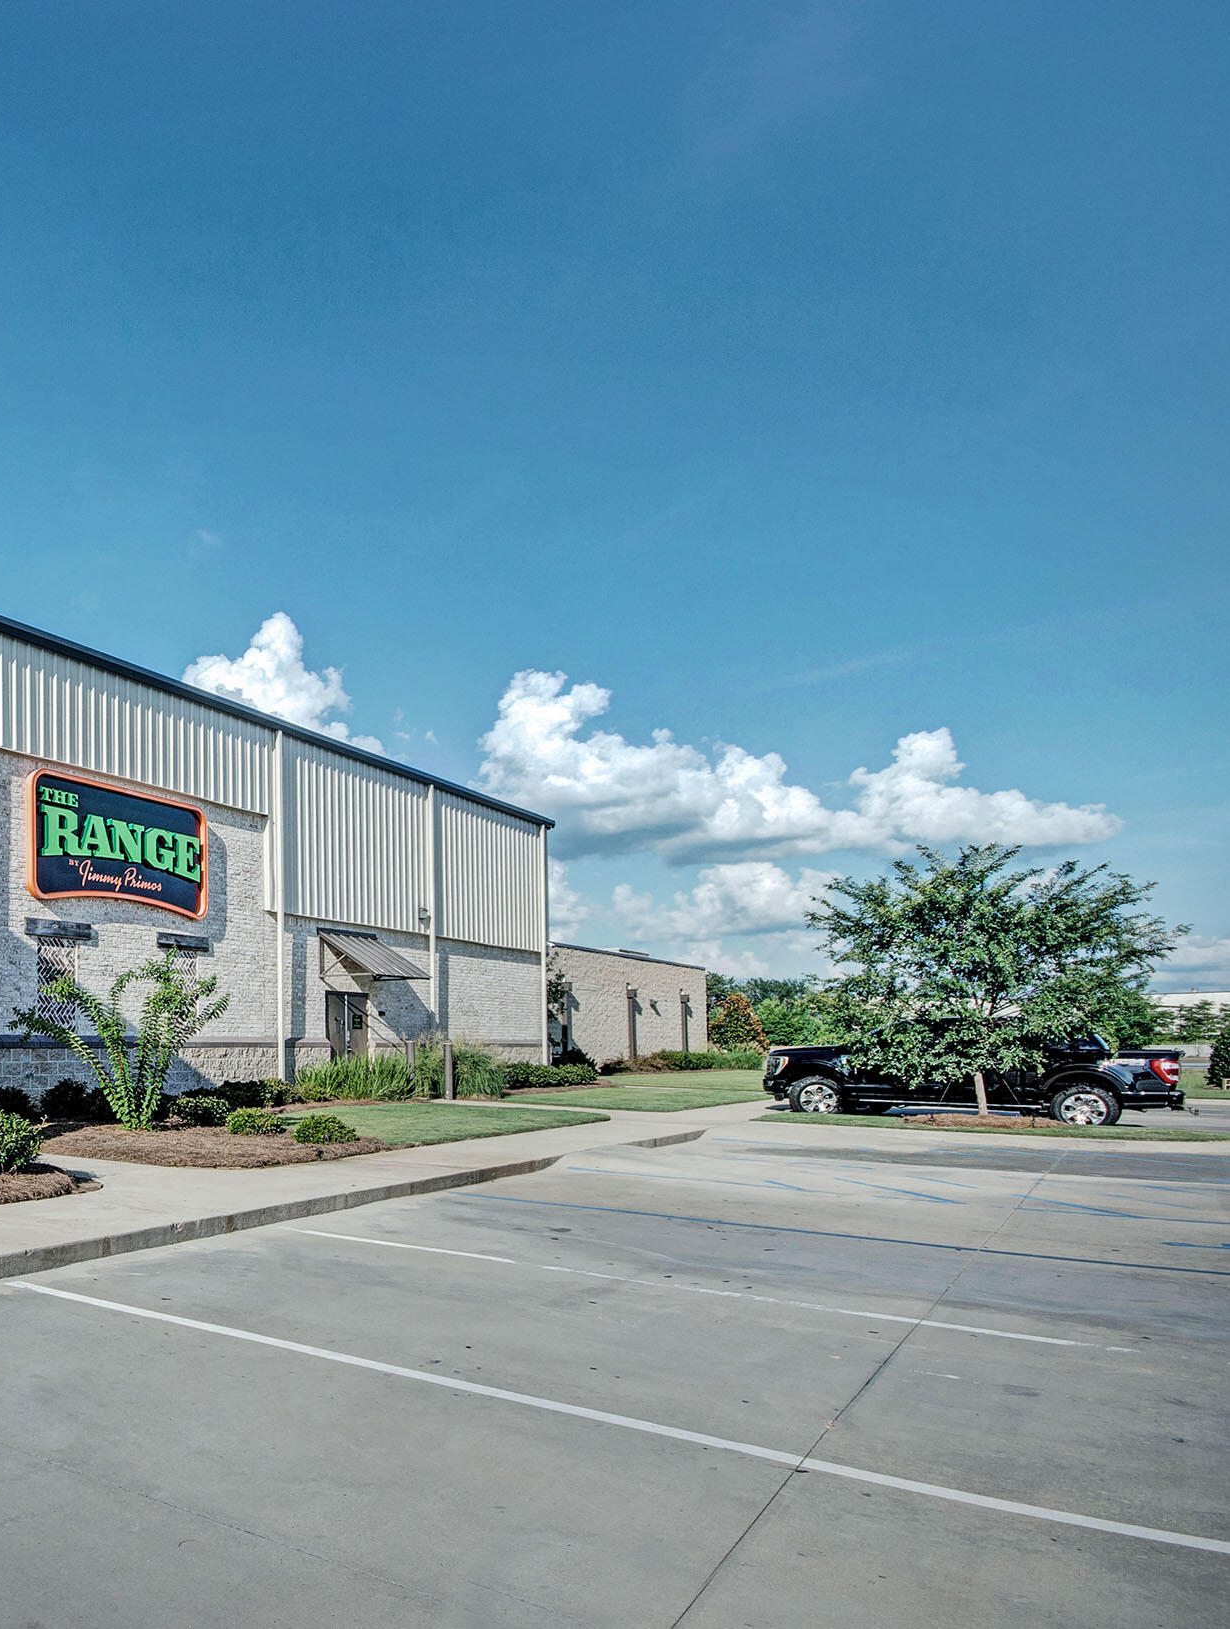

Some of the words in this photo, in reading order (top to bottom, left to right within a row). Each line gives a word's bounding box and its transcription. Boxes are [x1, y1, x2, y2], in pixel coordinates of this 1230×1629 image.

[39, 785, 79, 808] THE
[41, 803, 201, 883] RANGE
[78, 859, 123, 892] Jimmy
[123, 867, 163, 892] Primos
